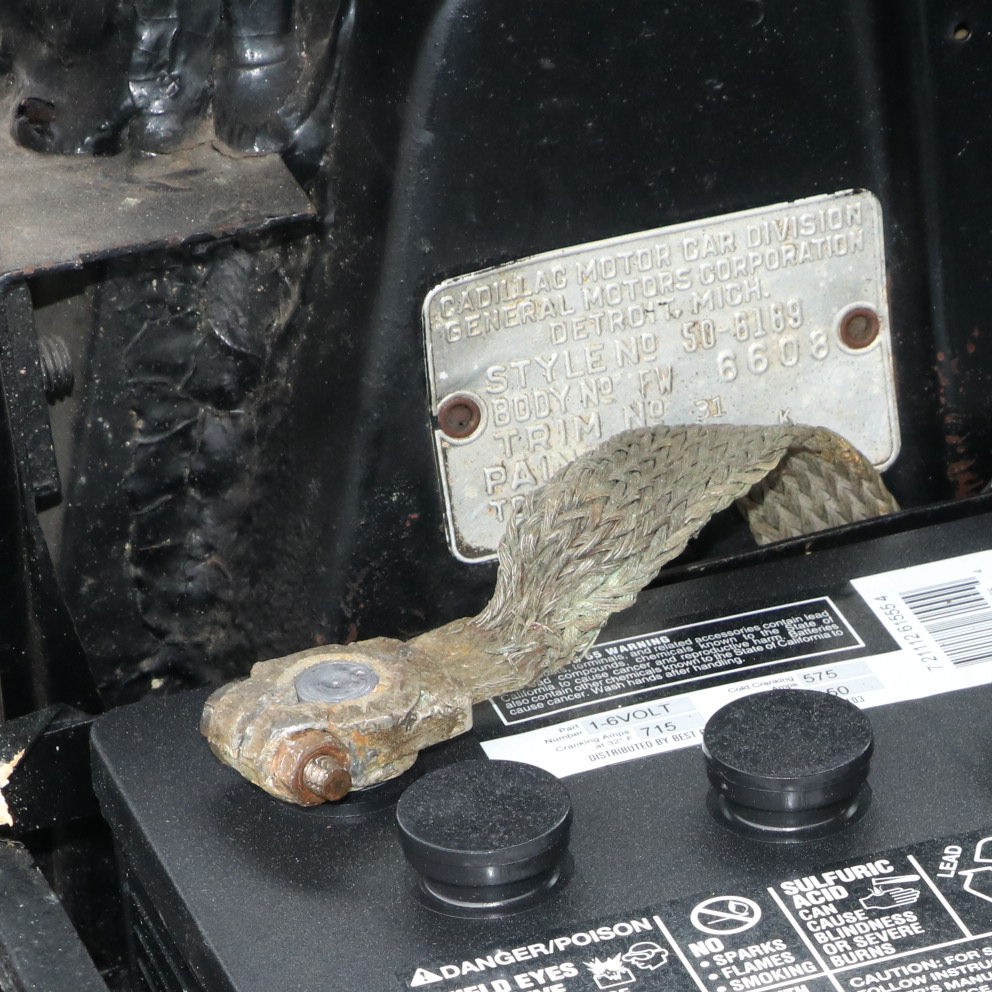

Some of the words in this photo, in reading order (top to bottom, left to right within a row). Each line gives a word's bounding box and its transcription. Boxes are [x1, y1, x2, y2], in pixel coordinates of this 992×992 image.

[440, 264, 568, 318] CADILLAC
[576, 244, 671, 285] MOTOR
[683, 232, 736, 262] CAR
[747, 202, 862, 248] DIVISION
[445, 294, 576, 343] GENERAL
[582, 267, 692, 310] MOTORS
[700, 228, 864, 286] CORPORATION
[692, 279, 770, 314] MICH.
[486, 343, 607, 394] STYLE
[492, 385, 570, 427] BODY
[494, 412, 602, 458] TRIM
[557, 660, 630, 681] compounds,
[635, 646, 694, 663] chemicals
[699, 636, 738, 650] known
[742, 632, 756, 640] to
[760, 627, 780, 637] the
[786, 620, 817, 631] State
[820, 616, 834, 625] of
[570, 653, 628, 670] terminals,
[630, 646, 651, 658] and
[654, 638, 693, 652] related
[695, 624, 760, 643] accessories
[762, 615, 804, 630] contain
[804, 610, 830, 622] lead
[605, 636, 670, 656] WARNING
[500, 684, 556, 703] California
[560, 680, 570, 688] to
[574, 672, 608, 684] cause
[612, 664, 652, 676] cancer
[655, 654, 677, 667] and
[680, 640, 750, 660] reproductive
[752, 634, 786, 646] harm.
[788, 623, 839, 638] Batteries
[506, 696, 529, 710] also
[531, 686, 574, 704] contain
[576, 680, 604, 692] other
[606, 666, 662, 685] chemicals
[664, 658, 700, 672] known
[702, 654, 712, 662] to
[714, 648, 732, 660] the
[734, 644, 762, 656] State
[765, 641, 776, 650] of
[777, 632, 832, 648] California
[832, 630, 844, 638] to
[510, 702, 544, 716] cause
[548, 692, 590, 706] cancer.
[591, 680, 626, 696] Wash
[628, 674, 662, 686] hands
[666, 666, 691, 678] after
[694, 656, 746, 672] handling.
[728, 684, 750, 694] Cold
[752, 676, 794, 688] Cranking
[803, 669, 838, 683] 575
[544, 730, 582, 744] Number
[589, 704, 670, 730] 1-6VOLT
[556, 737, 600, 752] Cranking
[602, 730, 630, 740] Amps
[640, 722, 677, 736] 715
[558, 724, 579, 733] Part
[588, 740, 654, 762] DISTRIBUTED
[655, 737, 668, 746] BY
[672, 730, 698, 742] BEST
[937, 845, 962, 877] LEAD
[780, 860, 894, 896] SULFURIC
[792, 886, 848, 909] ACID
[798, 904, 838, 921] CAN
[806, 909, 868, 932] CAUSE
[814, 911, 918, 944] BLINDNESS
[439, 918, 653, 980] DANGER/POISON
[688, 937, 724, 958] NO
[712, 938, 787, 966] SPARKS
[822, 940, 852, 956] OR
[852, 922, 925, 948] SEVERE
[830, 943, 896, 967] BURNS
[514, 962, 579, 990] EYES
[721, 952, 796, 979] FLAMES
[730, 961, 818, 991] SMOKING
[850, 959, 943, 988] CAUTION:
[944, 950, 980, 966] FOR
